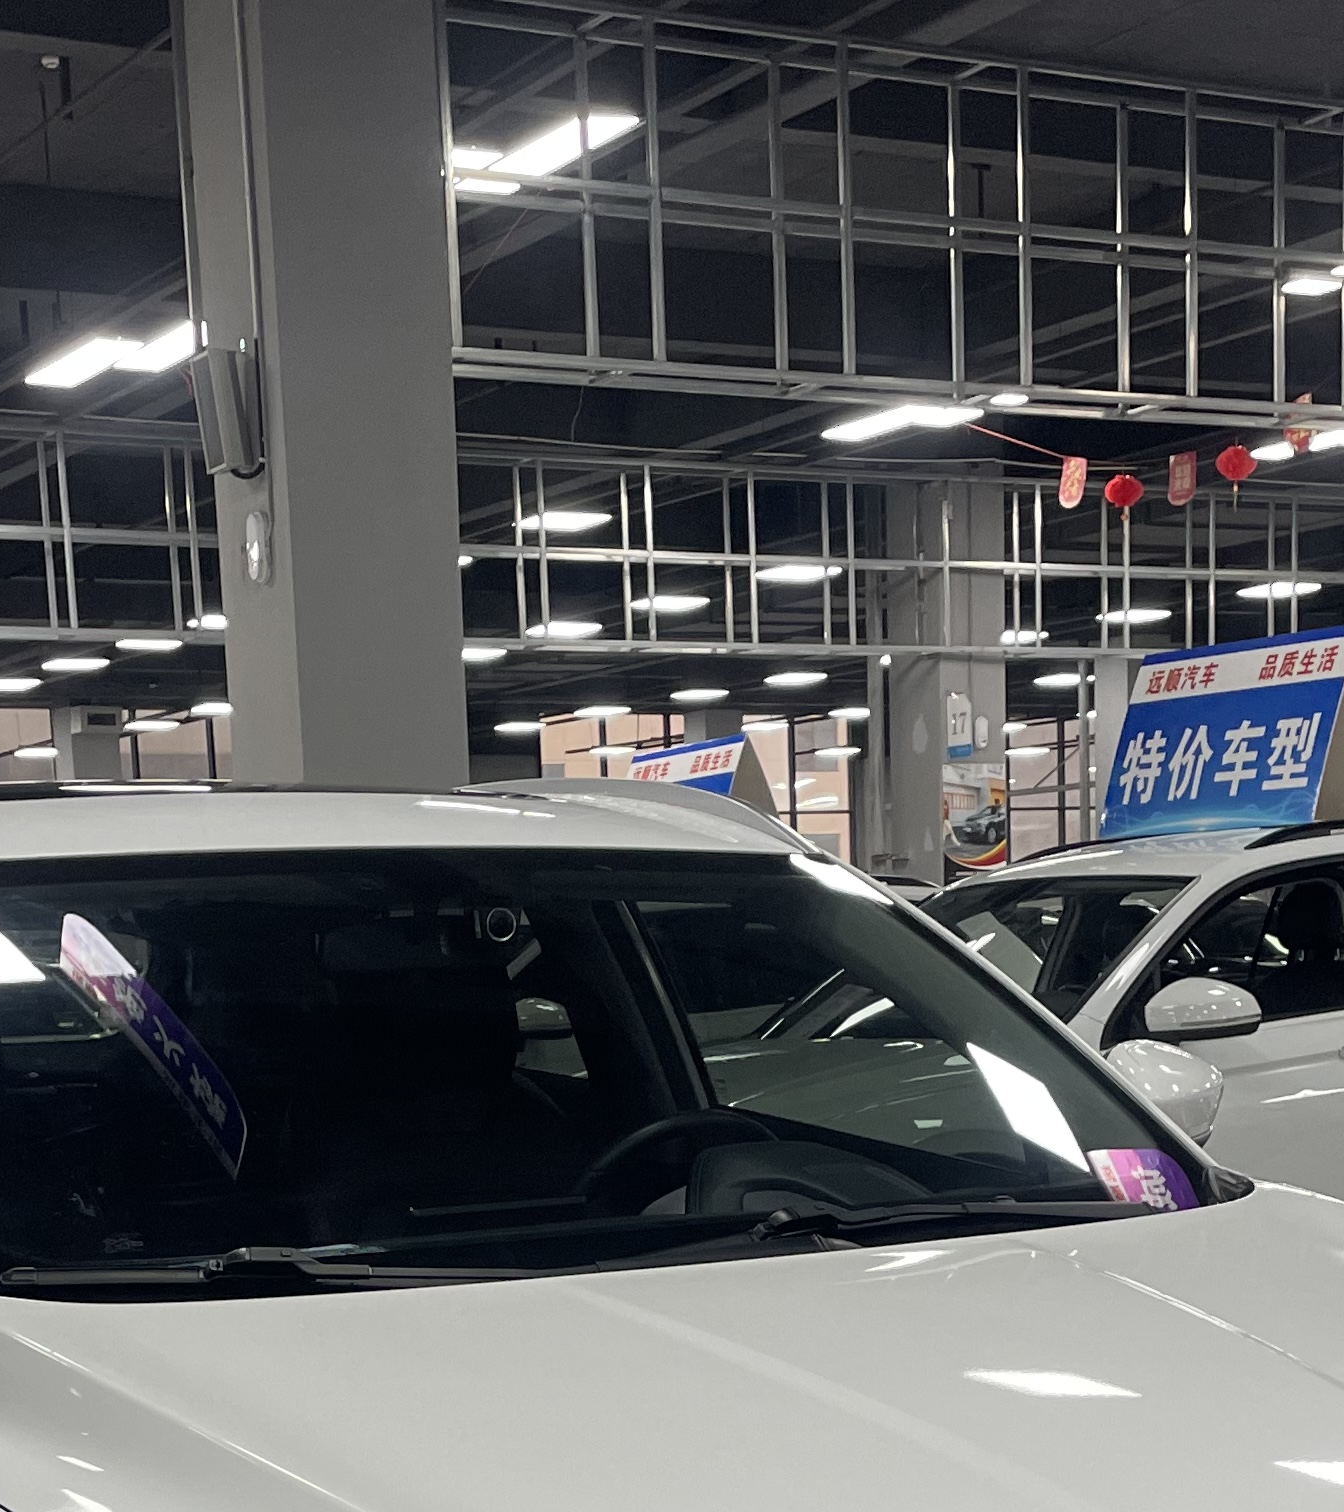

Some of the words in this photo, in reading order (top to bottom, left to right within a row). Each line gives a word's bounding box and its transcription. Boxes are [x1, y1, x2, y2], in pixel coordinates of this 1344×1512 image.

[1145, 662, 1219, 695] 远顺汽车
[1258, 645, 1339, 681] 品质生活
[952, 711, 967, 736] 17
[1119, 711, 1323, 805] 特价车型
